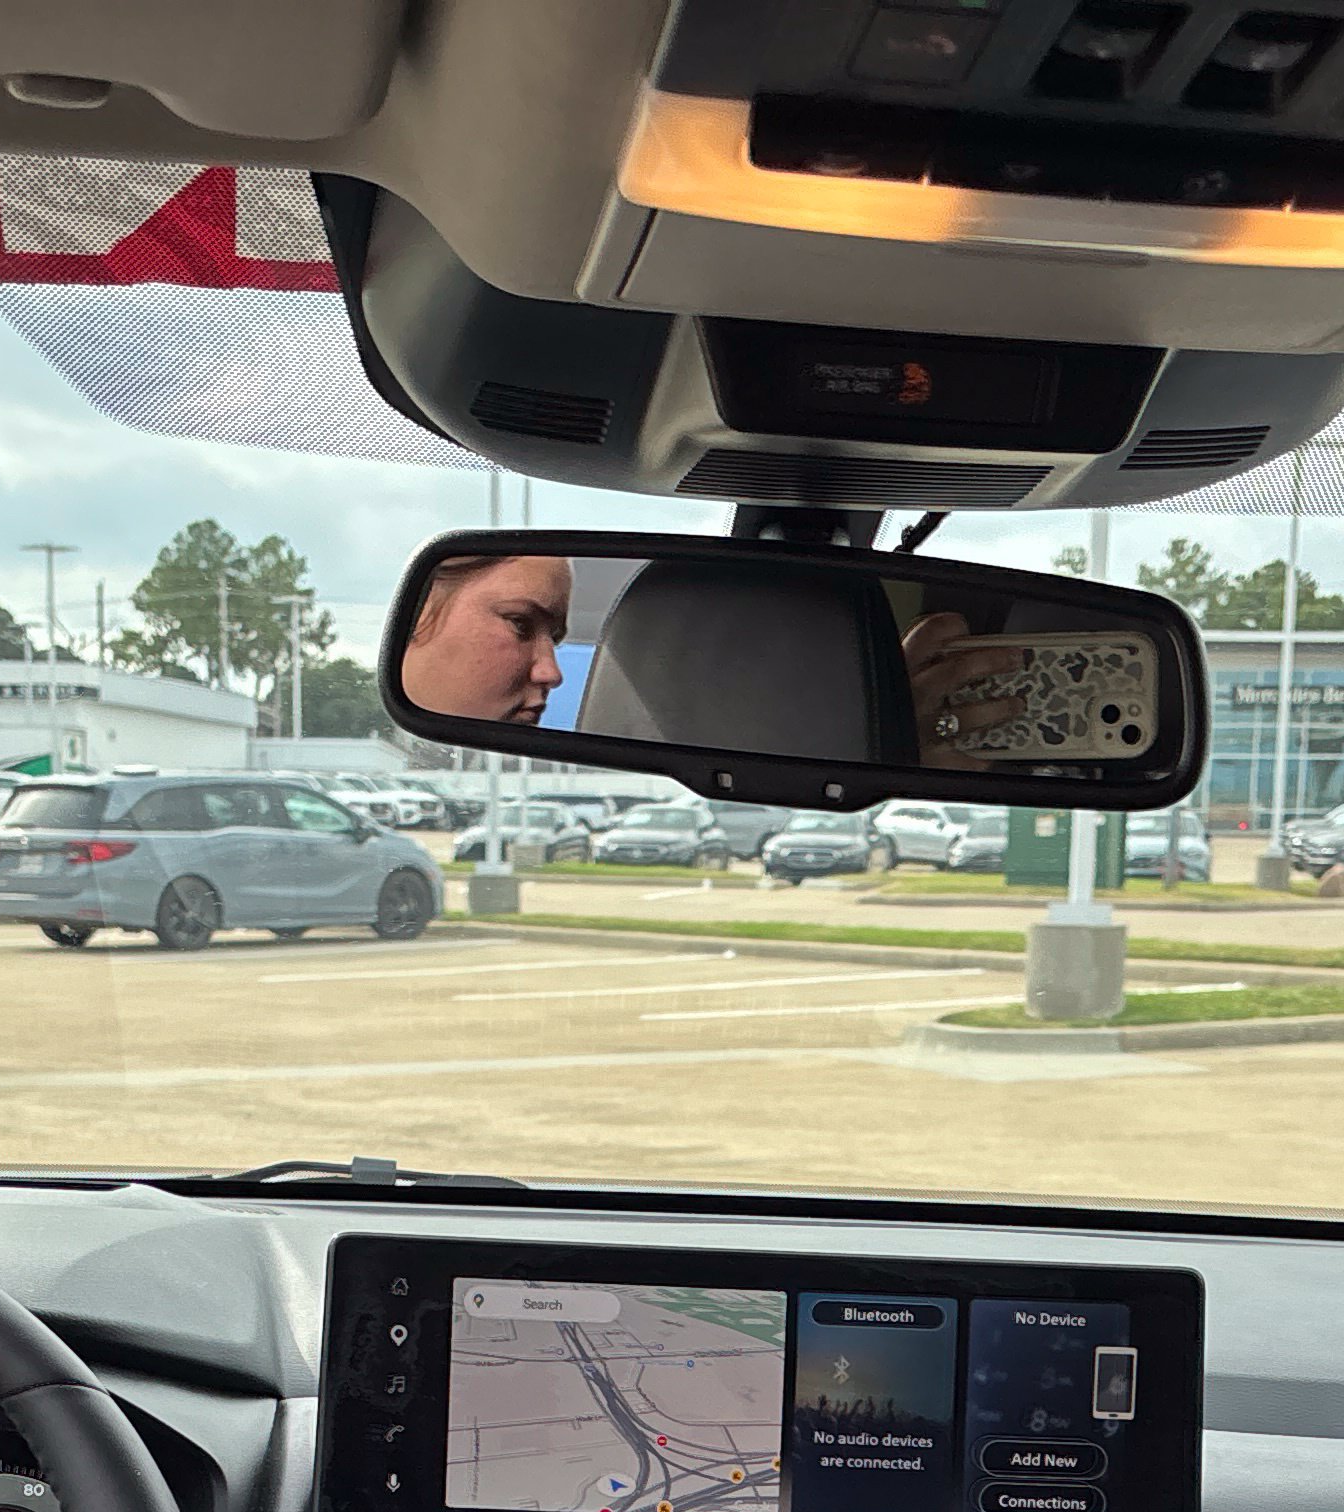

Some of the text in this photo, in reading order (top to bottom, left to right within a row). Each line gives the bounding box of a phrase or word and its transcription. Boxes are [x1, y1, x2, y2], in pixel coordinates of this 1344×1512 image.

[523, 1298, 563, 1312] Search
[843, 1308, 915, 1324] Bluetooth
[1016, 1311, 1086, 1328] No Device
[814, 1431, 934, 1448] No audio devices
[821, 1456, 925, 1471] are connected.
[1011, 1452, 1077, 1468] Add New
[23, 1483, 44, 1497] 80
[999, 1495, 1086, 1511] Connections
